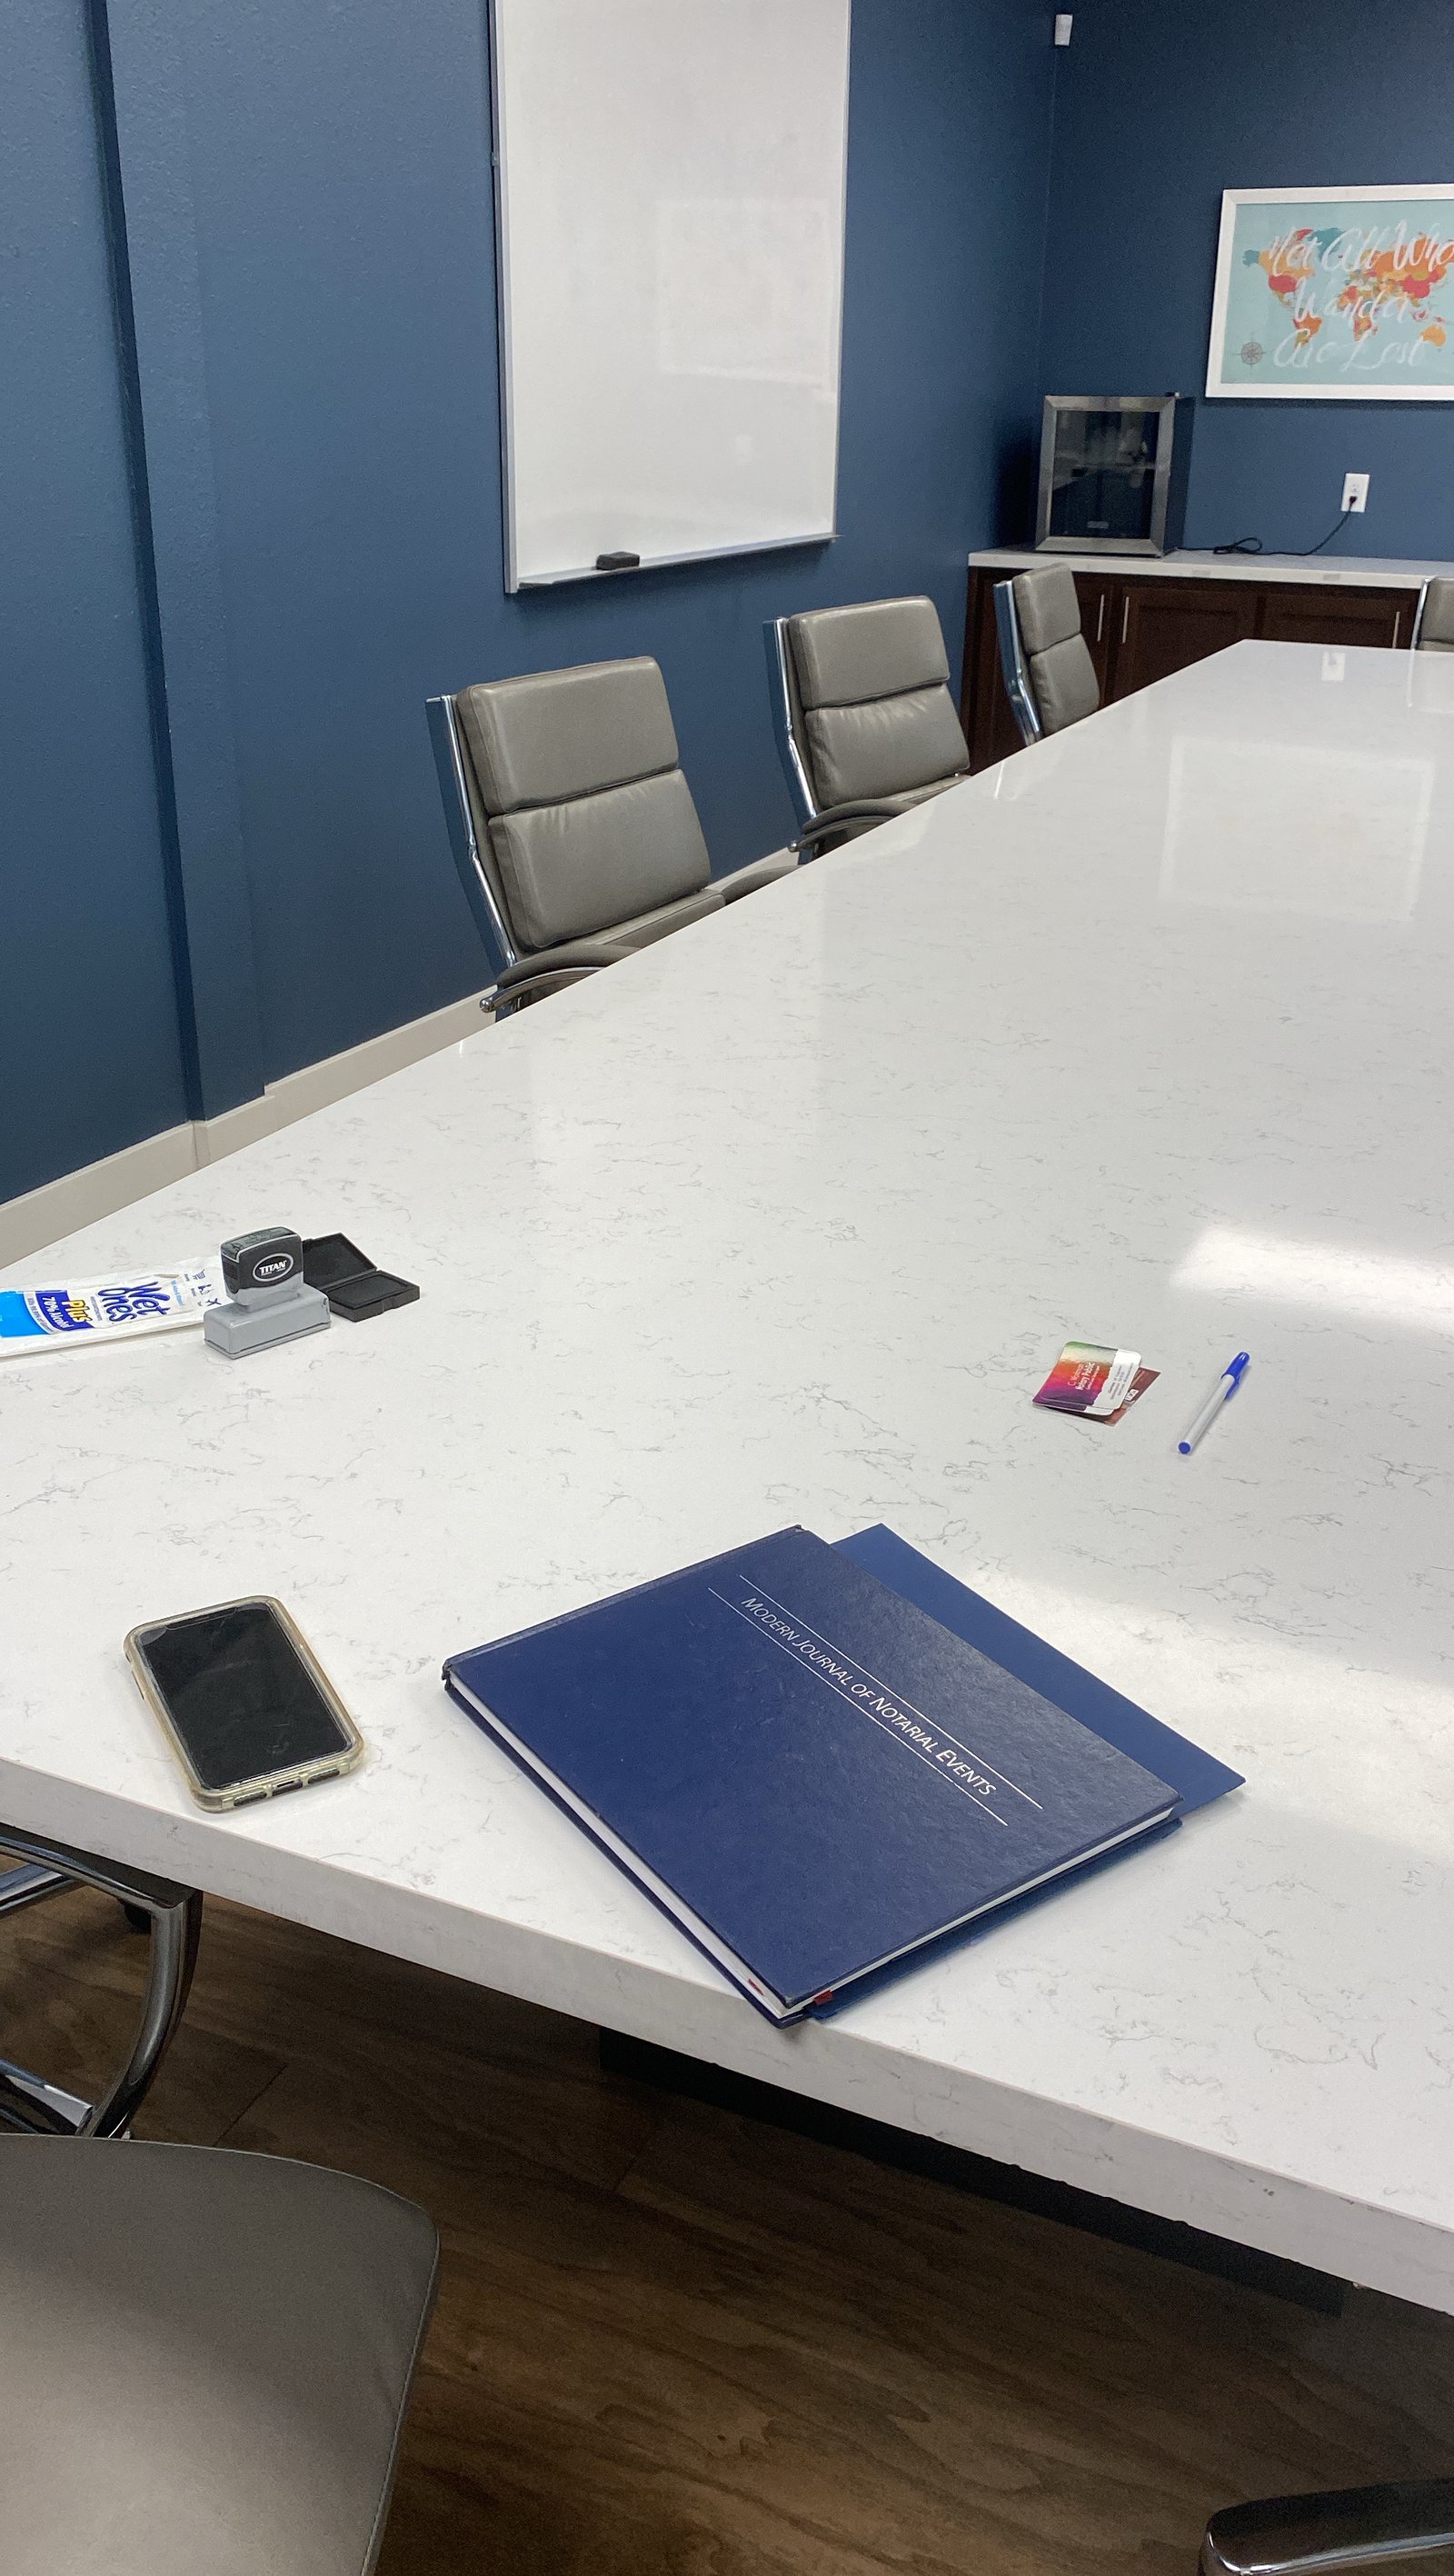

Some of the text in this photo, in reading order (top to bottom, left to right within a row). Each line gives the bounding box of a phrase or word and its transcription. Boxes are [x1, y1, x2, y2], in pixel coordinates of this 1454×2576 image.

[1321, 226, 1390, 272] All
[1294, 276, 1411, 328] Wander
[1339, 325, 1426, 372] Lost
[259, 1260, 287, 1275] TITAN
[42, 1296, 59, 1313] 70%
[61, 1299, 93, 1323] Plus
[128, 1281, 171, 1315] Wet
[48, 1312, 75, 1329] Alcohol
[741, 1597, 997, 1795] MODERN JOURNAL OF NOTARIAL EVENTS
